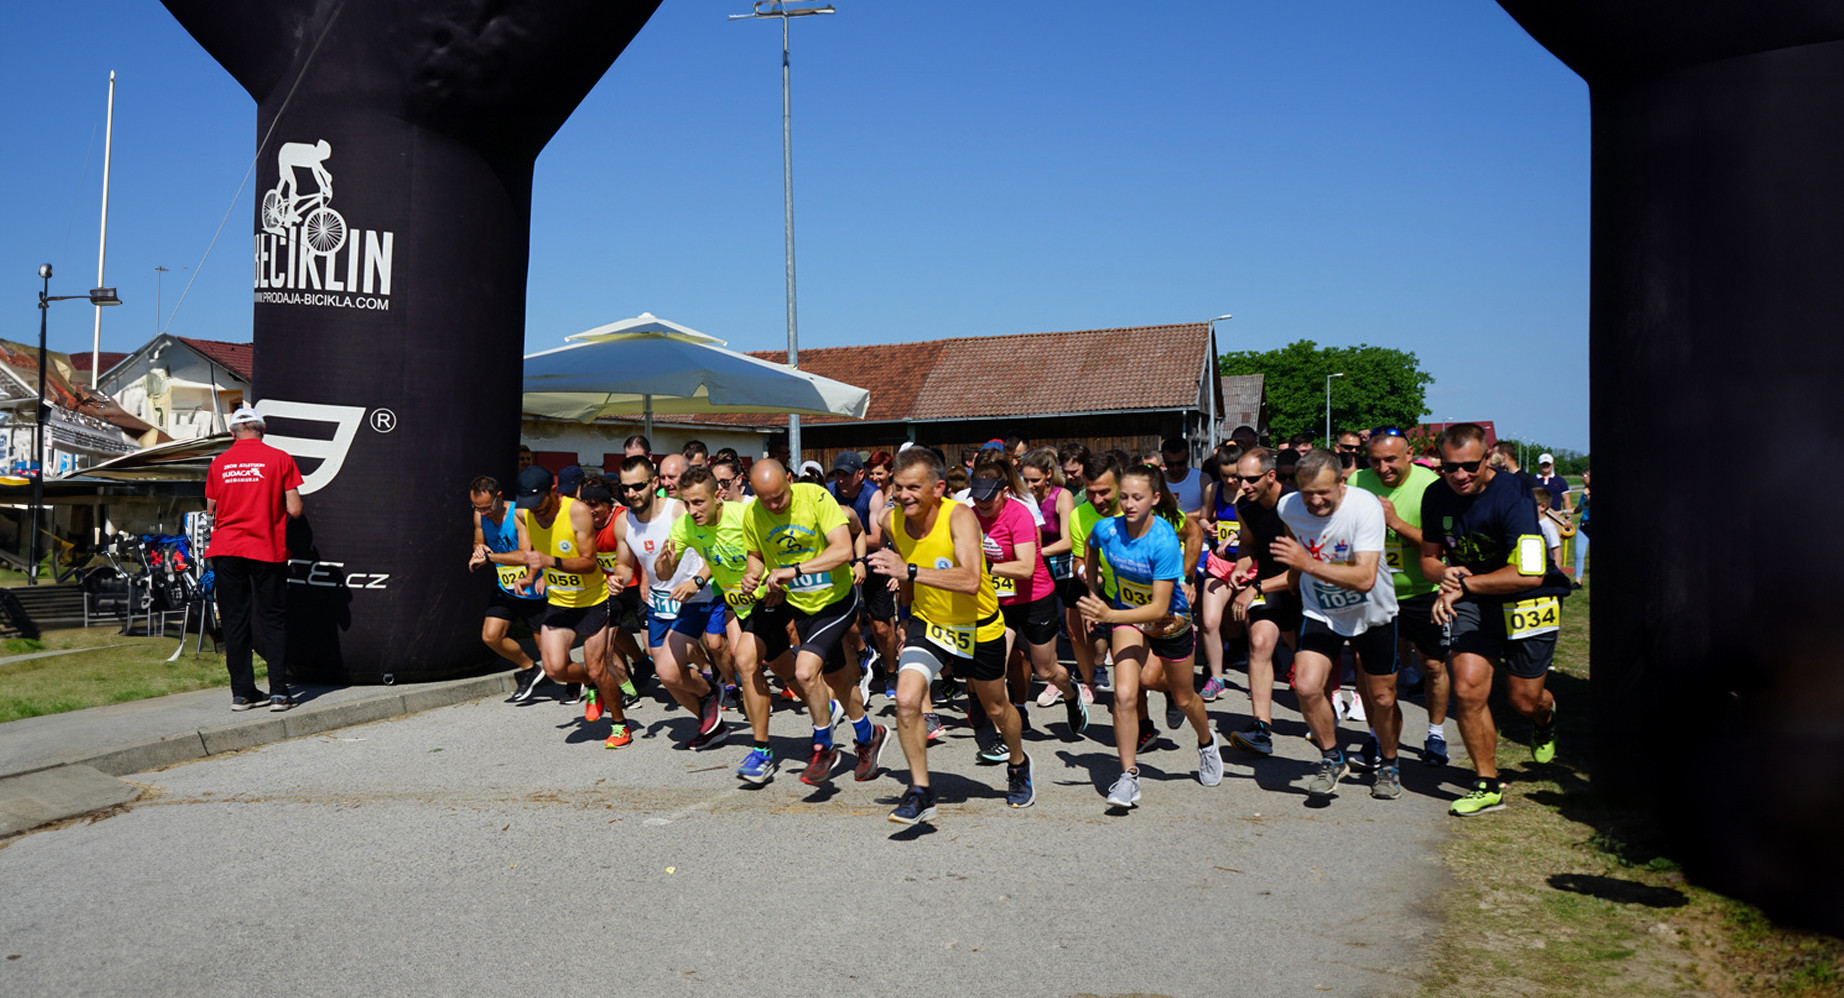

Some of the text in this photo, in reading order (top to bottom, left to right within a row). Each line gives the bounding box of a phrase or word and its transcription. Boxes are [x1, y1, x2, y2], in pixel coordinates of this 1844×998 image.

[254, 291, 389, 311] .PRODAJA-BICIKLA.COM
[548, 573, 580, 587] 058
[991, 576, 1013, 590] 54
[728, 593, 757, 606] 068
[1319, 591, 1362, 608] 105
[1510, 607, 1556, 630] 034
[931, 625, 970, 650] 055
